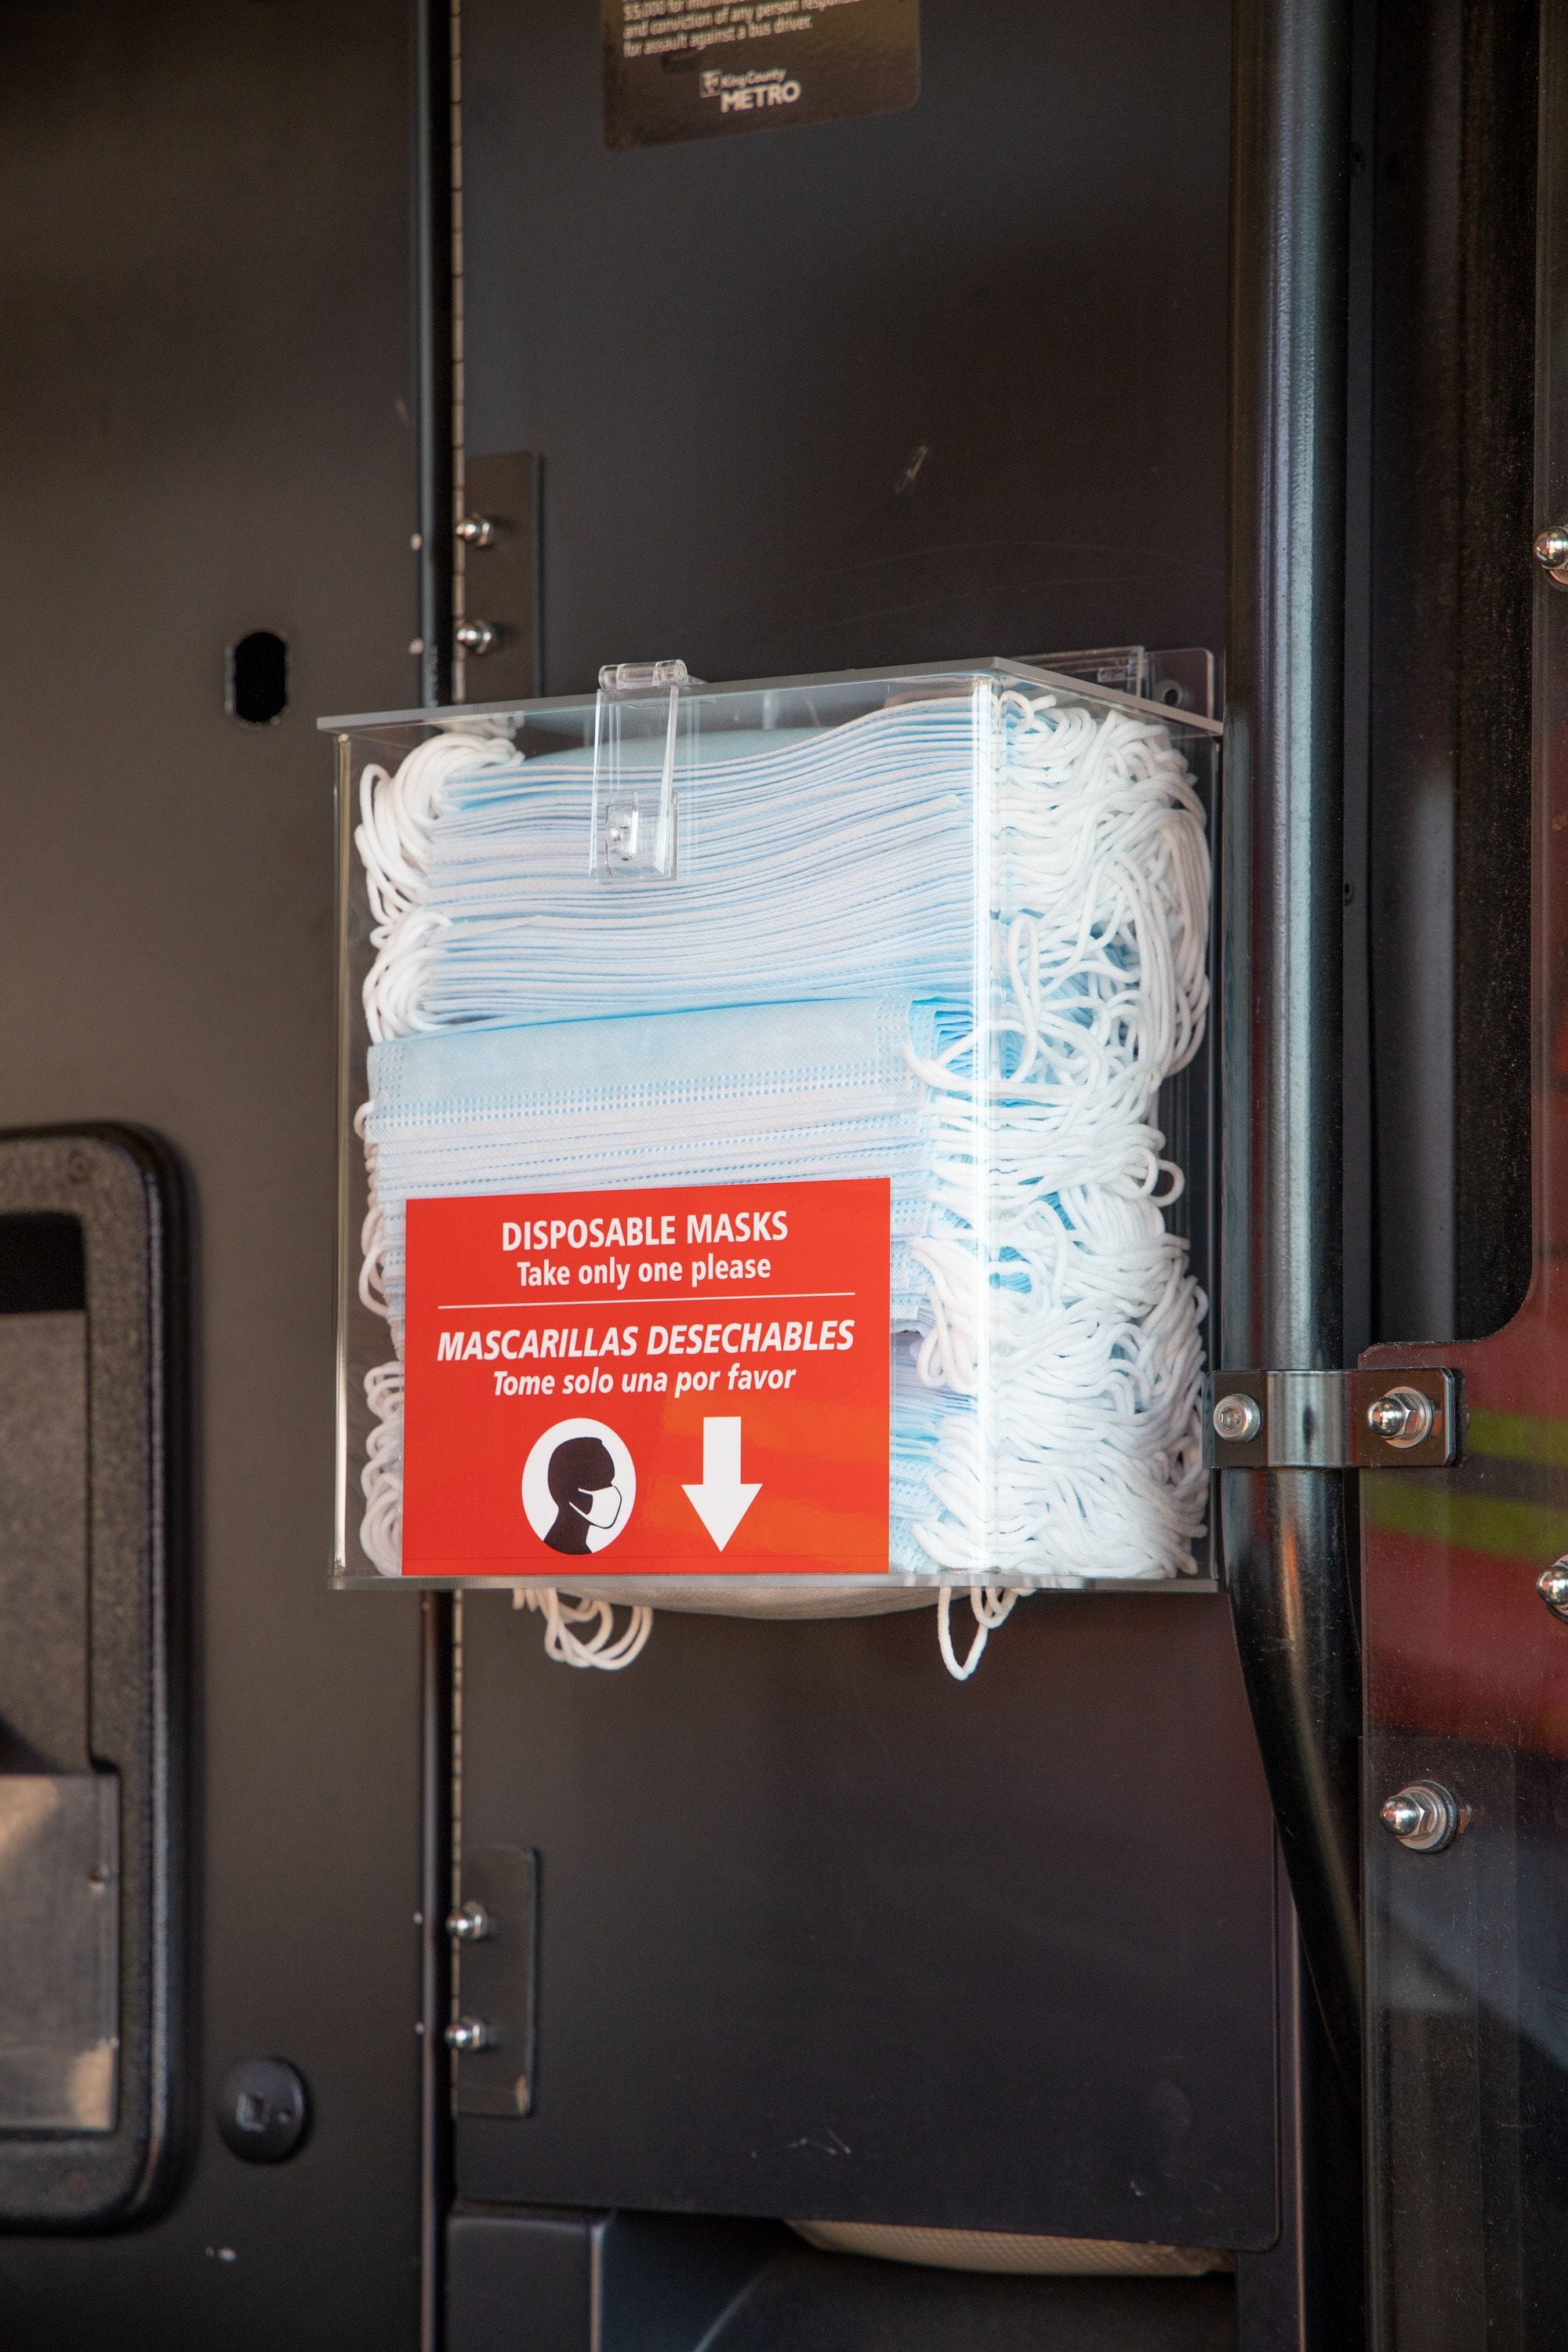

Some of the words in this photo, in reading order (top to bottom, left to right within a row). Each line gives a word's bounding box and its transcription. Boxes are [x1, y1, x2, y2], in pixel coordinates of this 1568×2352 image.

[623, 19, 649, 39] and
[649, 11, 713, 35] conviction
[713, 6, 730, 25] of
[729, 4, 754, 24] any
[755, 1, 800, 22] person
[623, 39, 643, 58] for
[643, 32, 688, 55] assault
[688, 25, 735, 50] against
[736, 25, 747, 40] a
[748, 22, 772, 38] bus
[720, 80, 801, 114] METRO
[503, 1216, 676, 1251] DISPOSABLE
[687, 1210, 788, 1244] MASKS
[517, 1259, 571, 1287] Take
[578, 1257, 631, 1290] only
[638, 1261, 683, 1283] one
[691, 1254, 771, 1288] please
[437, 1326, 639, 1361] MASCARILLAS
[646, 1319, 855, 1356] DESECHABLES
[493, 1370, 555, 1396] Tome
[561, 1367, 614, 1395] solo
[621, 1372, 668, 1393] una
[674, 1370, 721, 1399] por
[726, 1363, 797, 1392] favor
